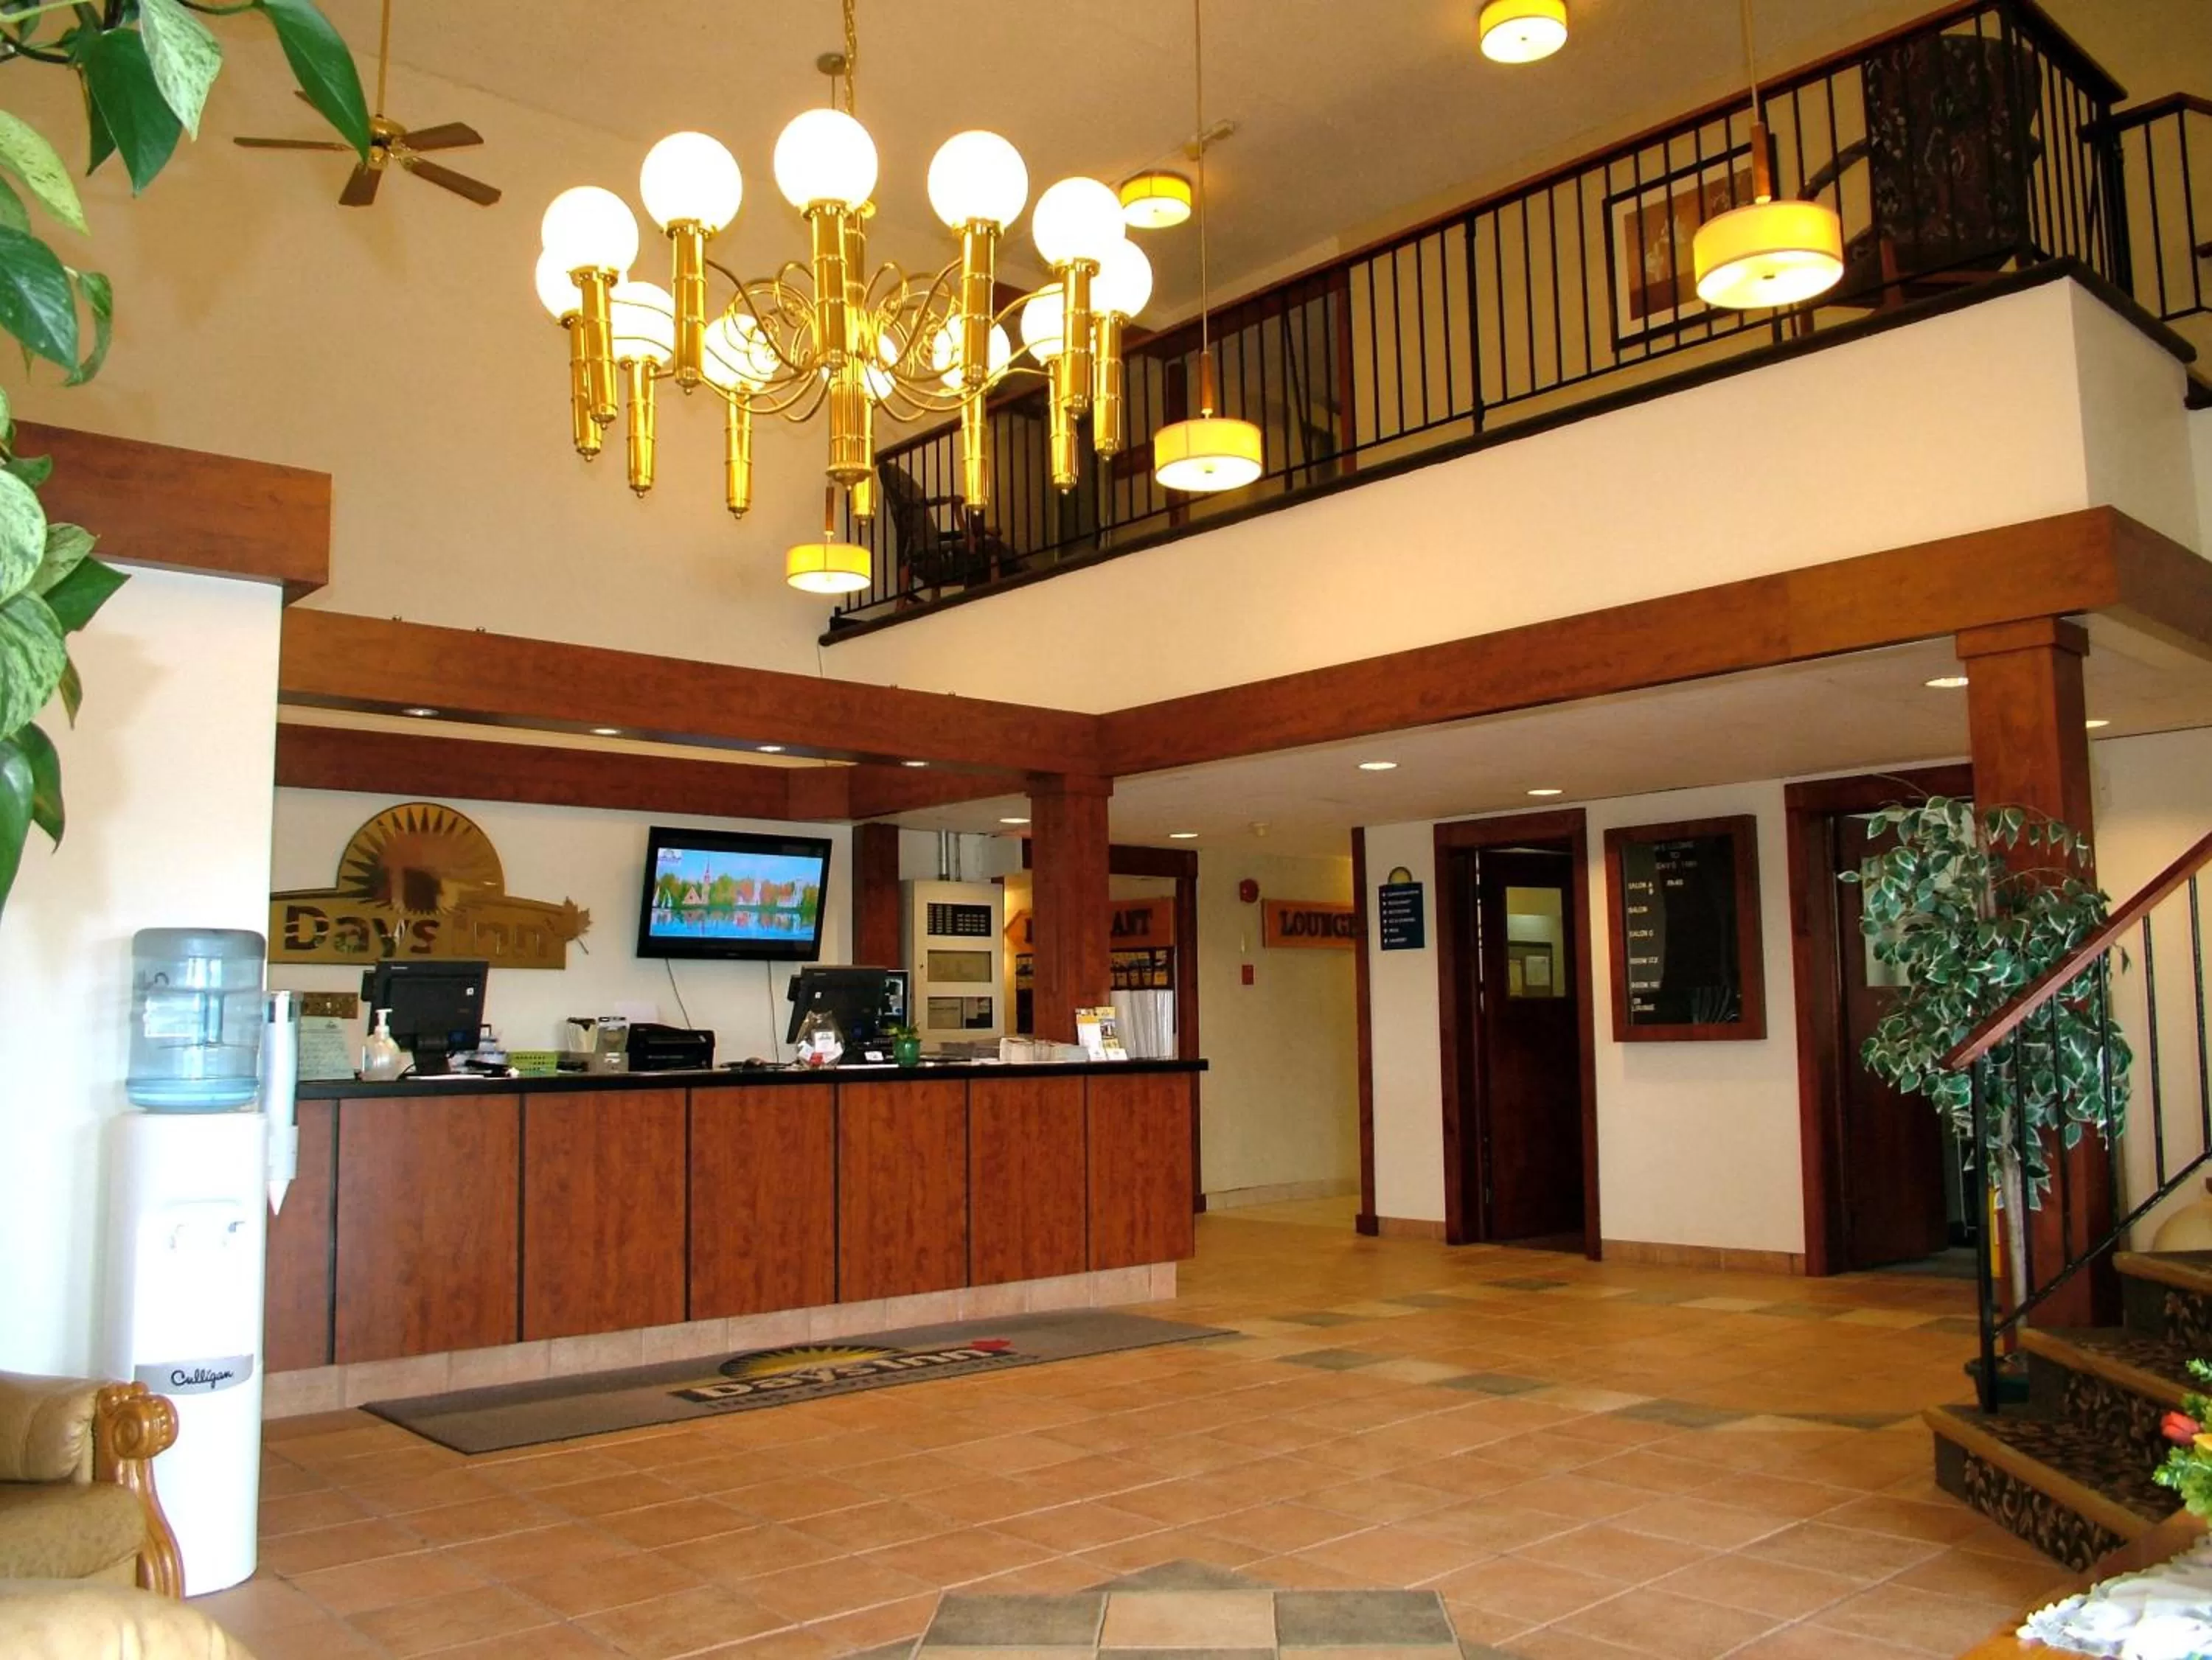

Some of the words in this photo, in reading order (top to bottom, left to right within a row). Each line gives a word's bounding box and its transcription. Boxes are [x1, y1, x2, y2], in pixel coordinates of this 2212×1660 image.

[283, 904, 440, 958] Days
[170, 1368, 234, 1389] Culligan
[691, 1363, 877, 1399] Days
[873, 1348, 994, 1370] Inn
